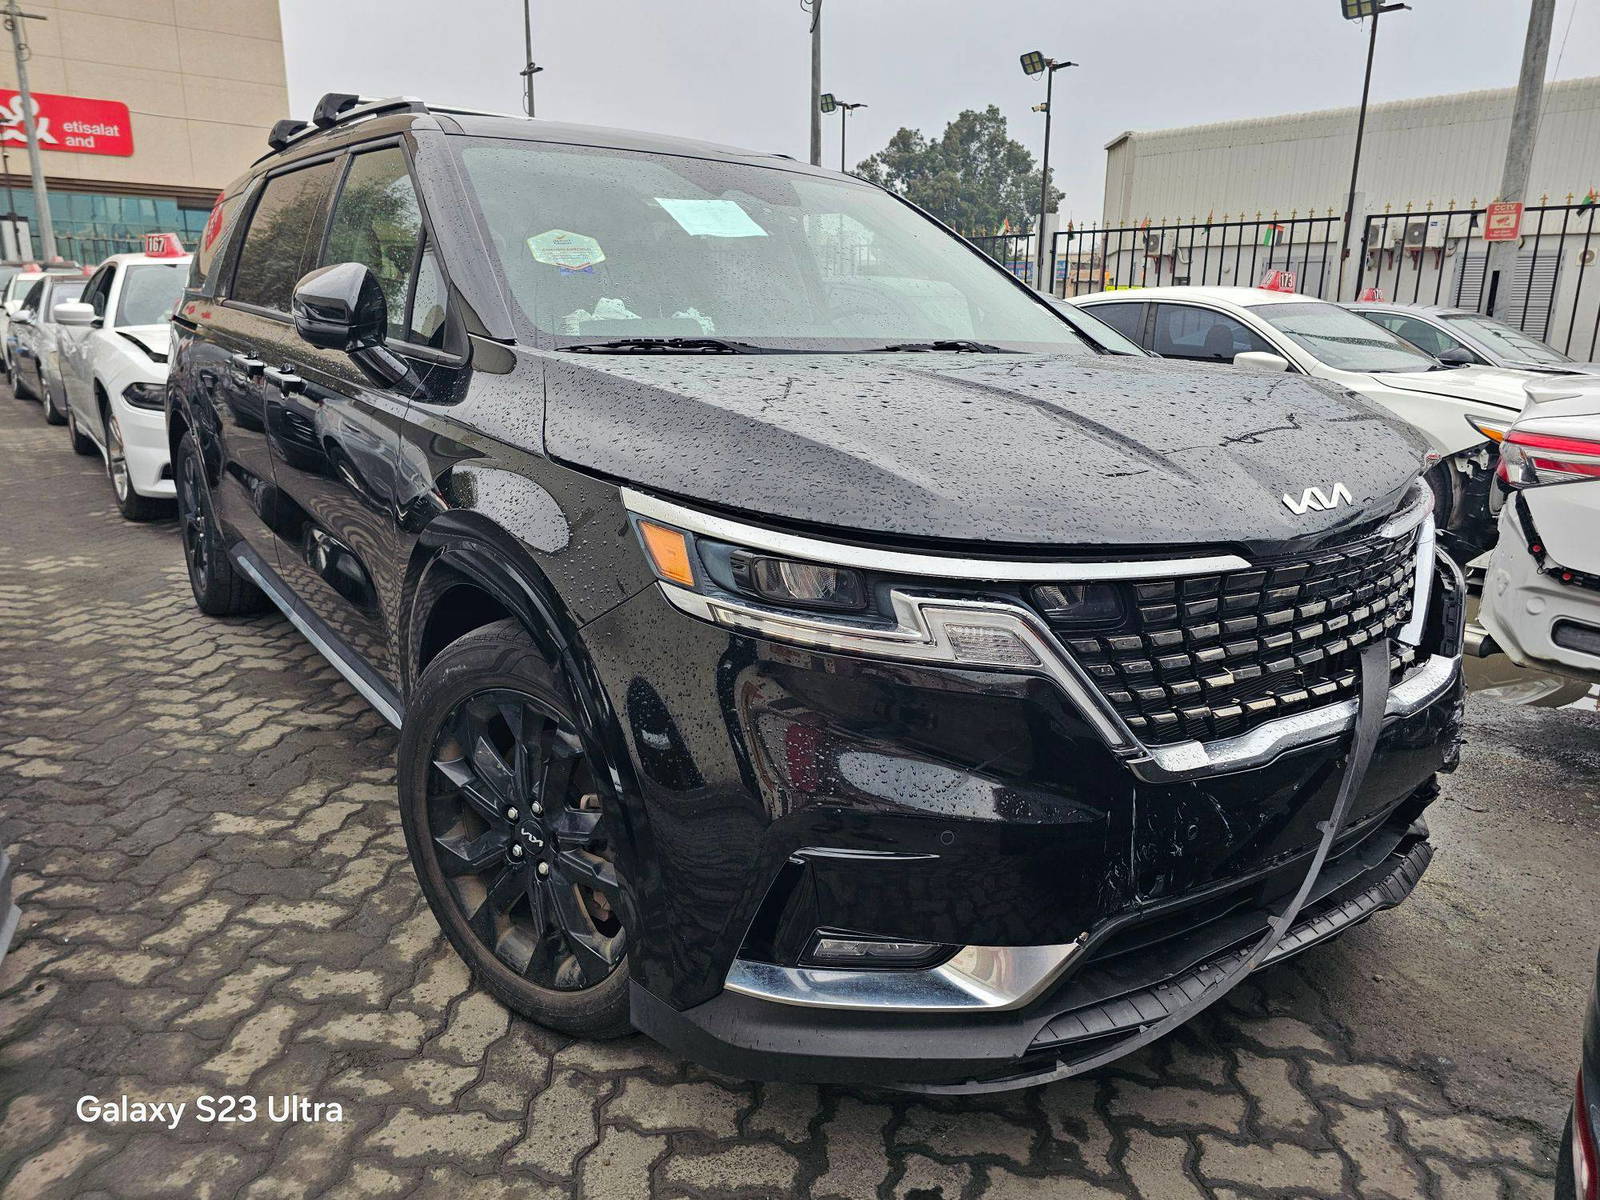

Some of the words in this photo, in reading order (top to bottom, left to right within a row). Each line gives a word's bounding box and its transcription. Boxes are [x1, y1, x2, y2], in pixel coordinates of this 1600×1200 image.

[63, 121, 120, 137] etisalat
[65, 136, 95, 148] and
[148, 236, 165, 252] 167
[1280, 272, 1294, 289] 173
